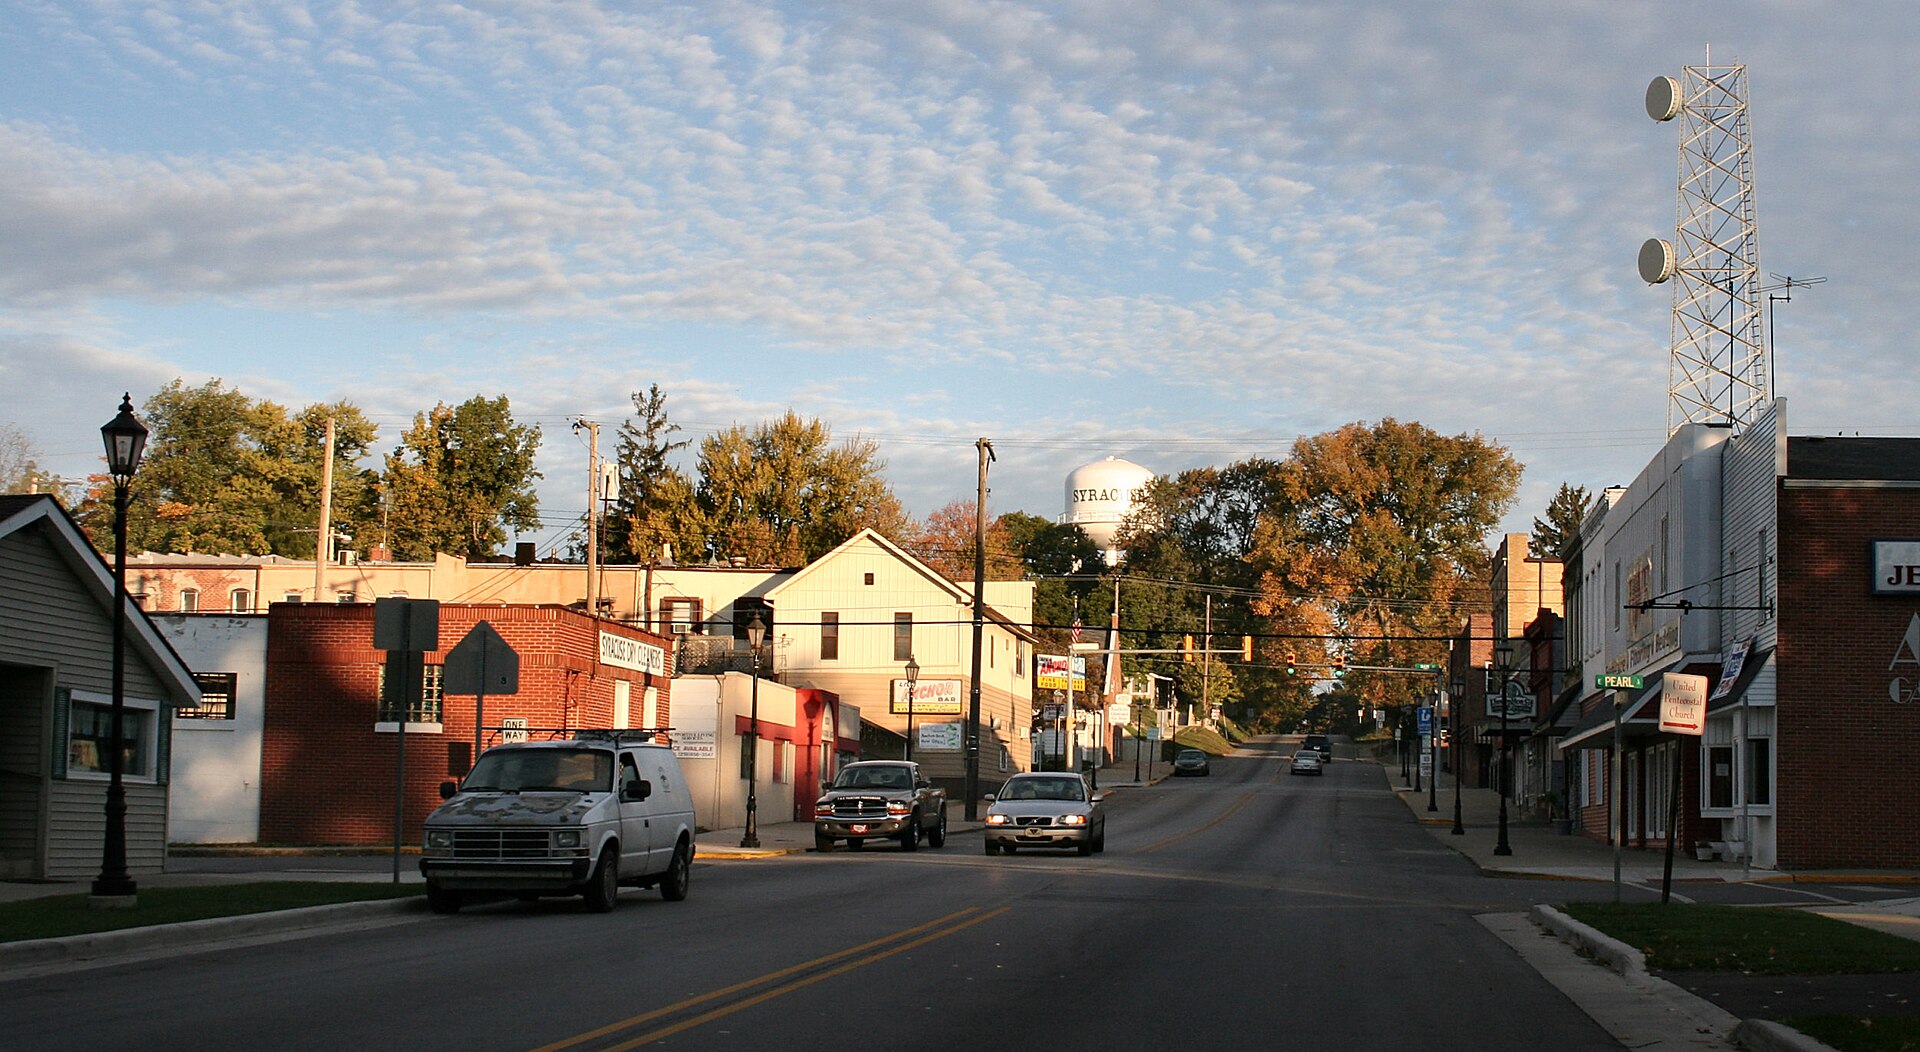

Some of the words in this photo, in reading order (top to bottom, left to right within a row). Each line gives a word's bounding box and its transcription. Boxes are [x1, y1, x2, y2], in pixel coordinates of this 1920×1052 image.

[602, 635, 626, 662] SYRACUSE
[627, 641, 637, 664] DRY
[638, 645, 661, 670] CLEANERS
[1040, 660, 1068, 676] ANCHO
[1605, 676, 1635, 688] PEARL
[1672, 680, 1697, 692] United
[1664, 693, 1702, 706] Pentecostal
[1669, 705, 1695, 720] Church
[505, 720, 524, 729] ONE
[504, 730, 524, 740] WAY
